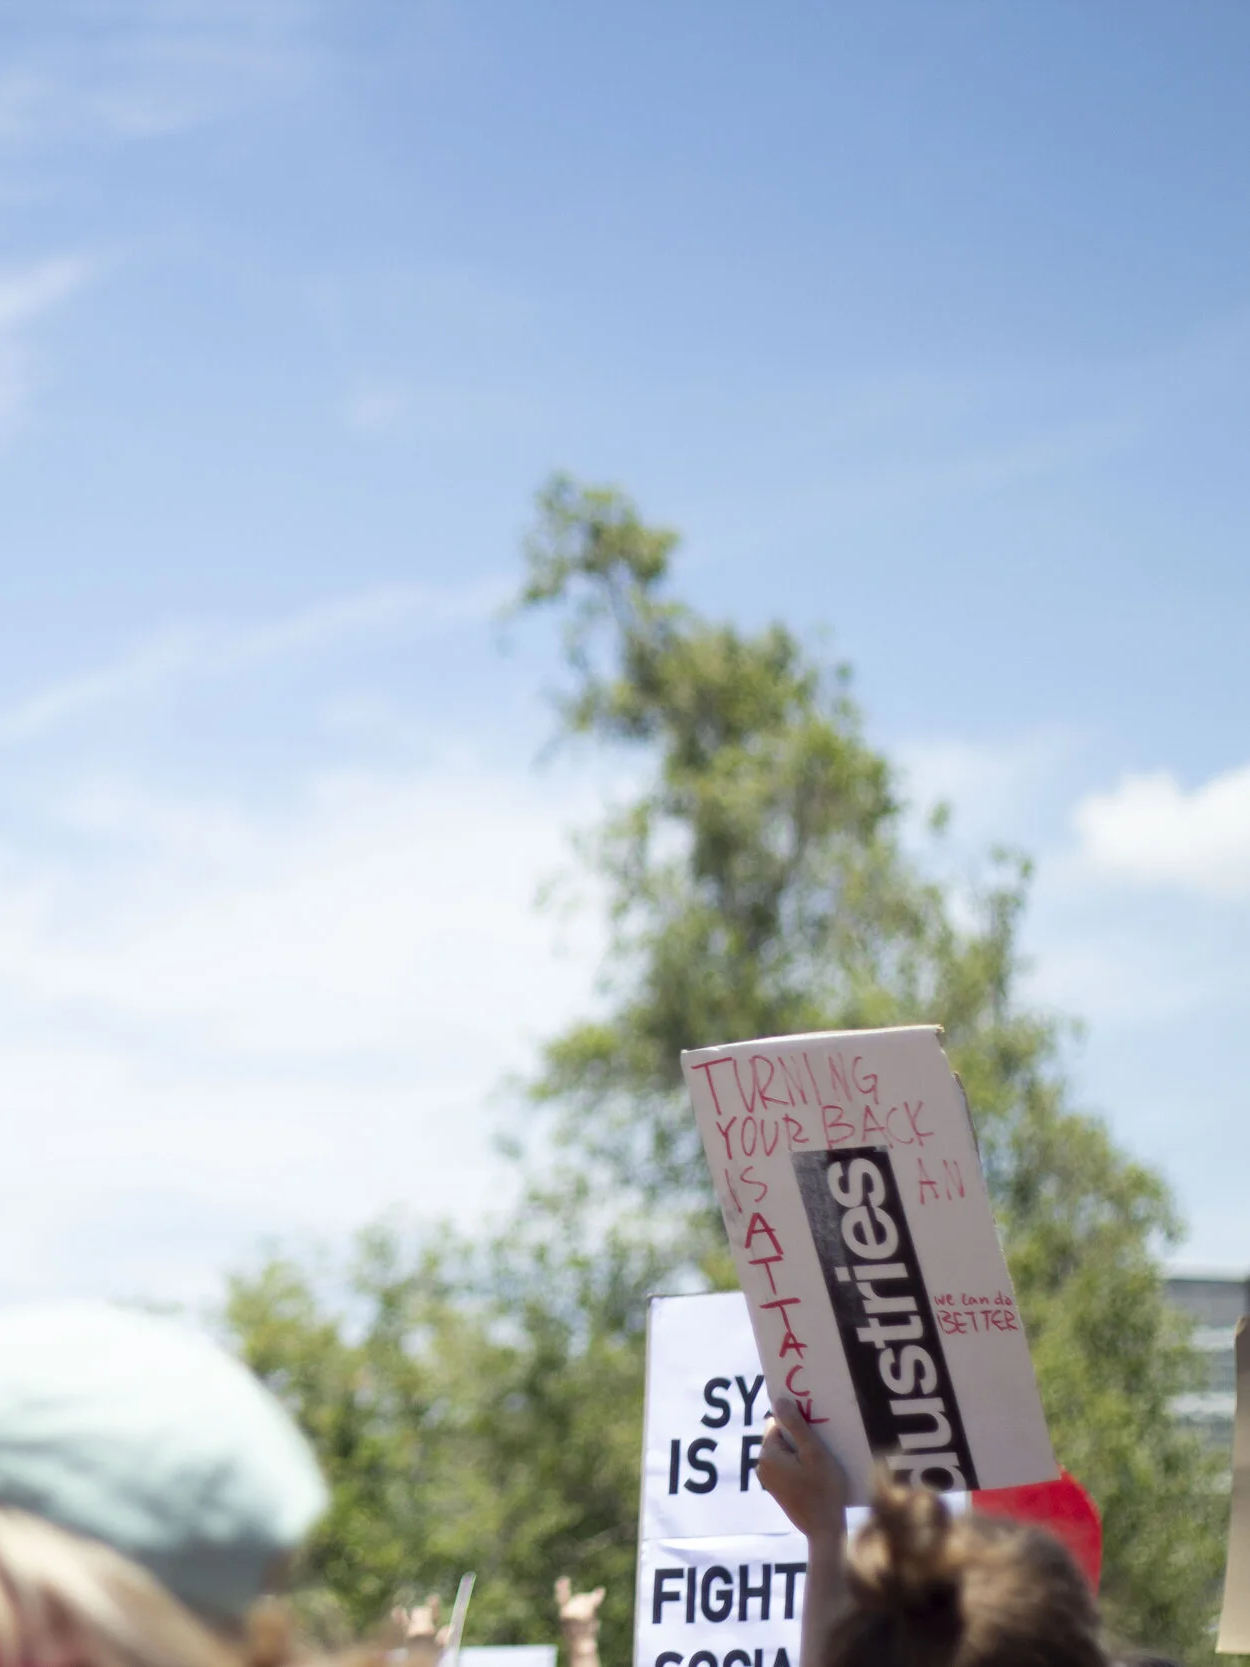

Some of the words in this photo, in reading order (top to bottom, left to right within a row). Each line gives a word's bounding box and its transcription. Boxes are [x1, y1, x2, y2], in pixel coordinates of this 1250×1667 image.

[691, 1052, 880, 1115] TURNING
[715, 1112, 809, 1160] YOUR
[822, 1101, 934, 1150] BACK
[724, 1166, 768, 1214] IS
[917, 1157, 966, 1205] AN
[744, 1212, 830, 1425] ATTACK
[936, 1309, 1019, 1335] BETTER
[668, 1437, 719, 1495] IS
[651, 1562, 807, 1625] FIGHT
